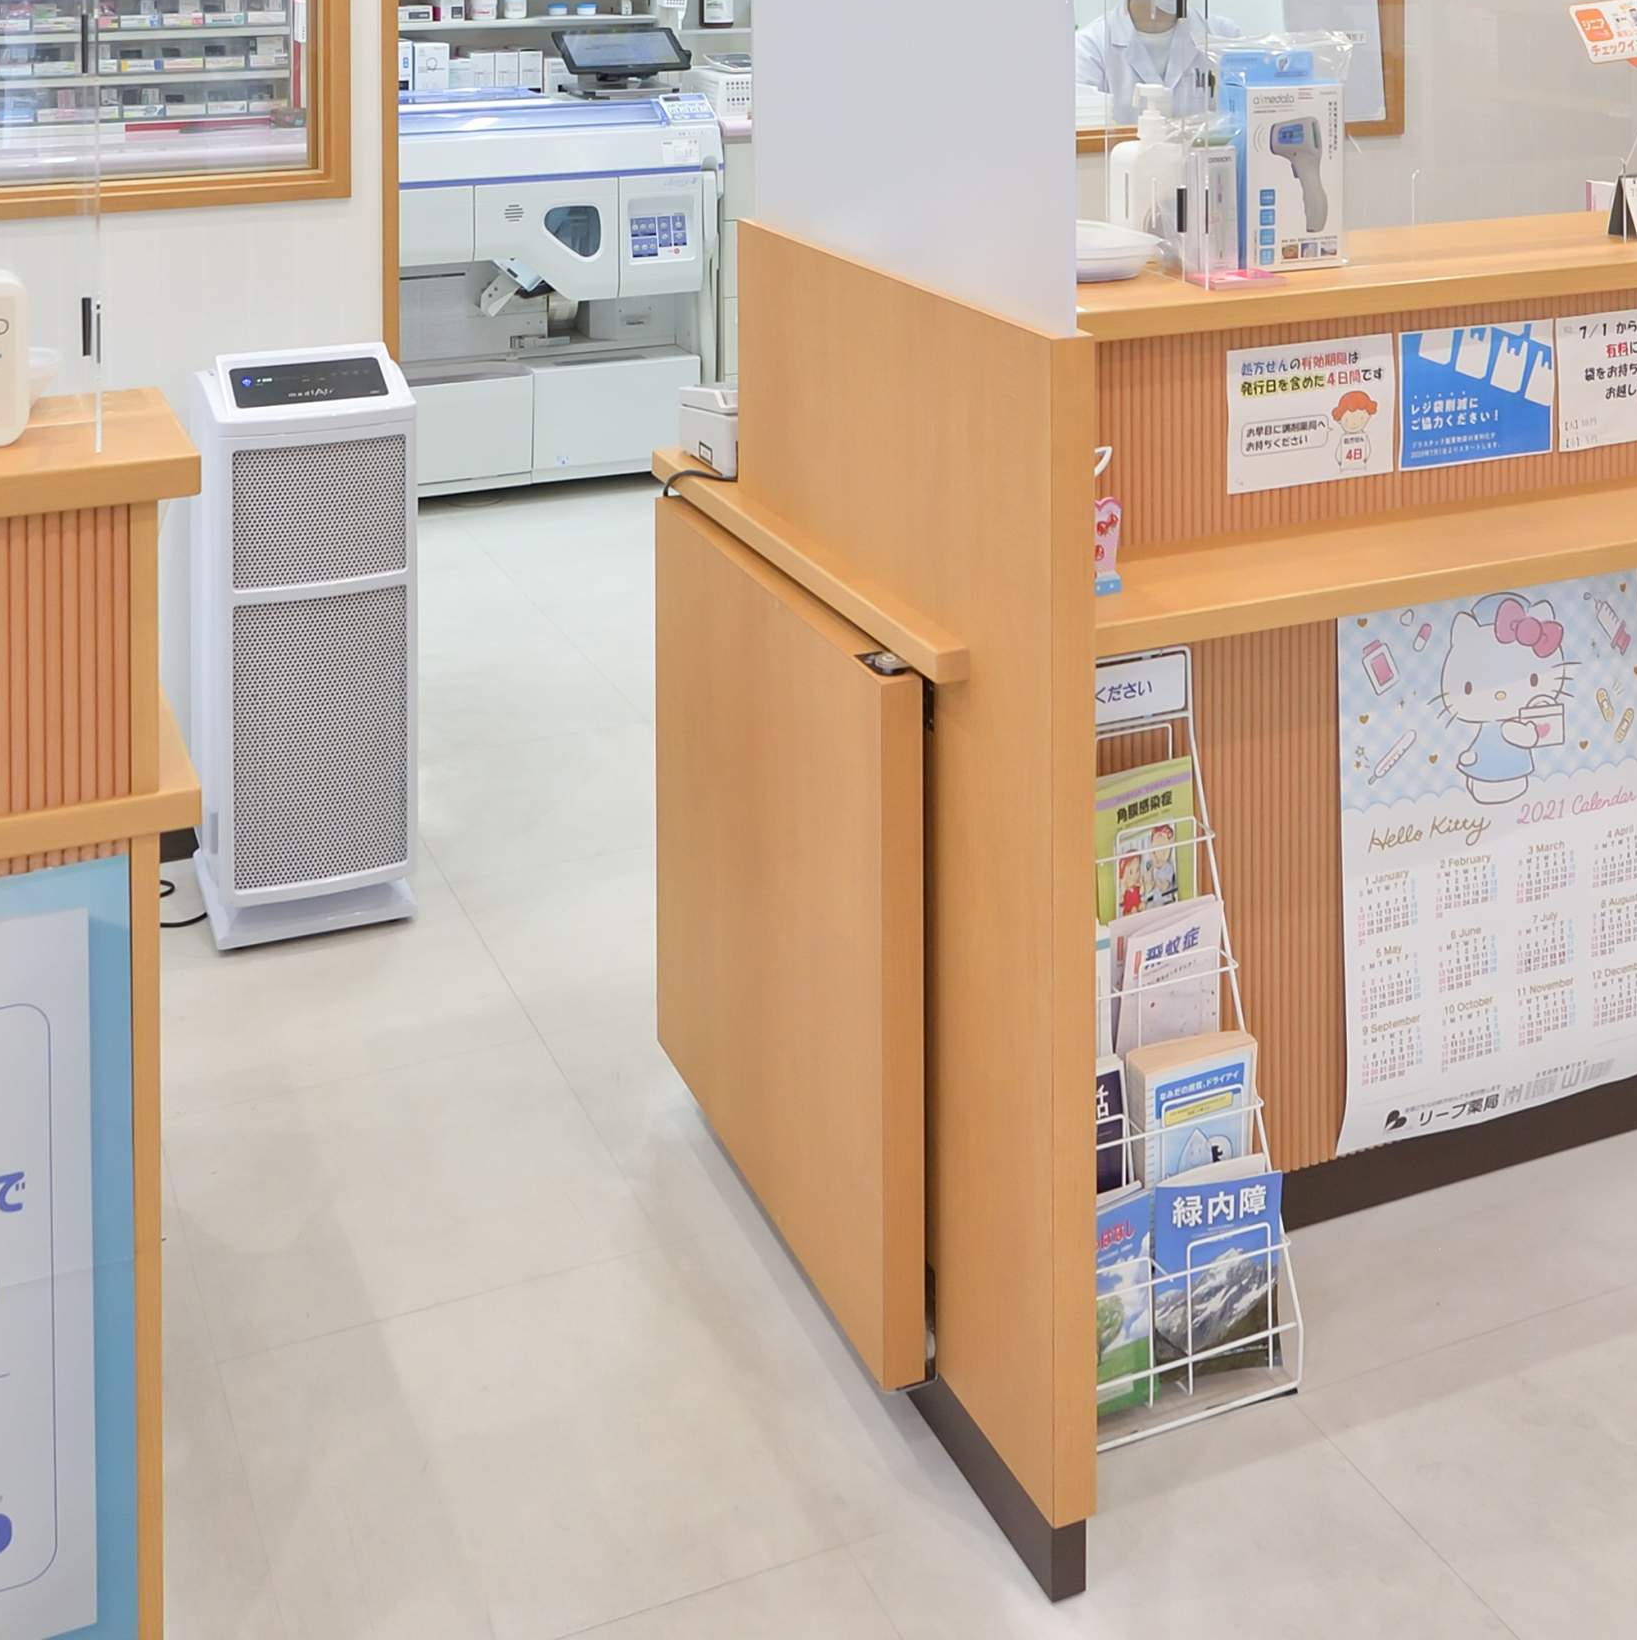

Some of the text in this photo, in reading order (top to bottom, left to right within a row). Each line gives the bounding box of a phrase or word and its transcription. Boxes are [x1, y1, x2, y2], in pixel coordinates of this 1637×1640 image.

[1582, 18, 1606, 32] シニア
[1240, 350, 1360, 377] 処方せんの有効期限は
[1411, 397, 1479, 416] レジ袋削減に
[1245, 434, 1309, 452] お持ちください
[1116, 790, 1173, 824] 角膜感染症
[1516, 785, 1637, 825] 2021 Calendar
[1368, 816, 1492, 853] Hello Kitty
[1614, 824, 1635, 838] April
[1535, 840, 1565, 853] March
[1448, 853, 1492, 868] February
[1372, 868, 1410, 886] January
[1540, 910, 1558, 925] July
[1458, 925, 1482, 938] June
[1383, 944, 1403, 959] May
[1529, 977, 1574, 994] November
[1457, 995, 1494, 1012] October
[1370, 1014, 1421, 1035] September
[1171, 1184, 1268, 1229] 緑内障
